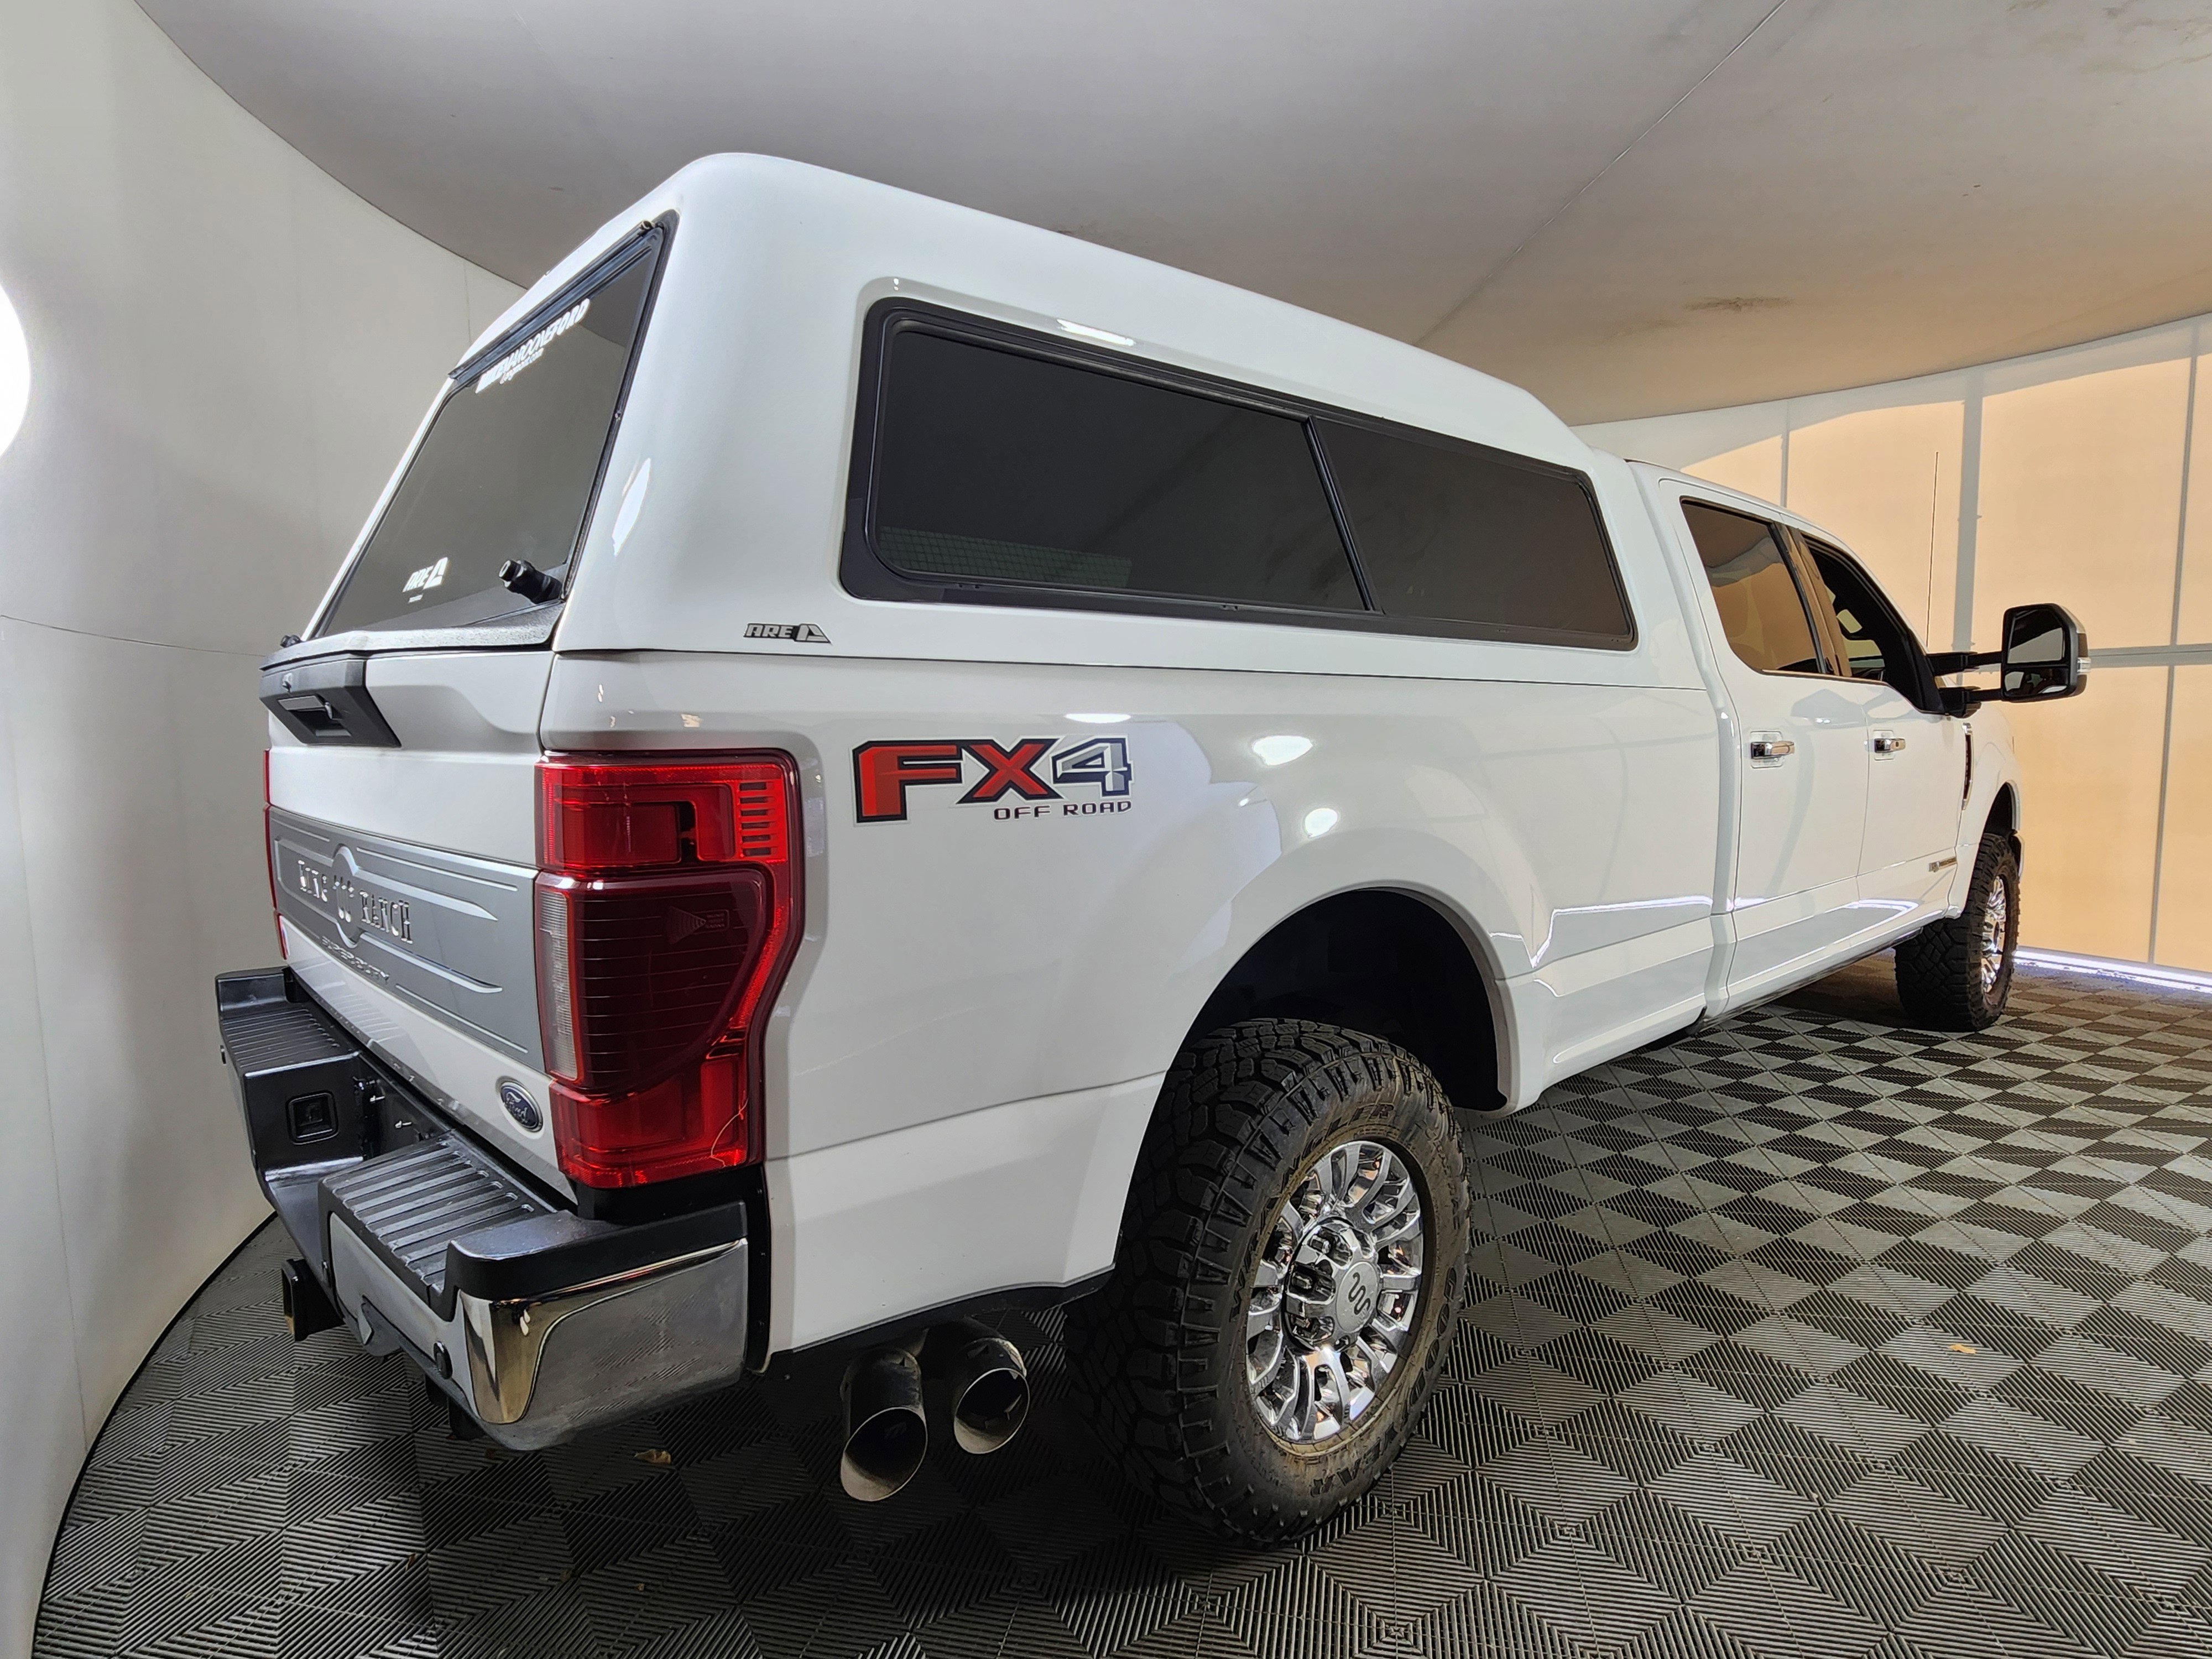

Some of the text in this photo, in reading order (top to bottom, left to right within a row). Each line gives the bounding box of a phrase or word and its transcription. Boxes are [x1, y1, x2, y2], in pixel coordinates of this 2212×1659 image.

[744, 623, 794, 639] ARE
[852, 737, 1134, 824] FX4
[994, 800, 1133, 821] OFF ROAD
[1310, 1267, 1457, 1498] GOODYEAR
